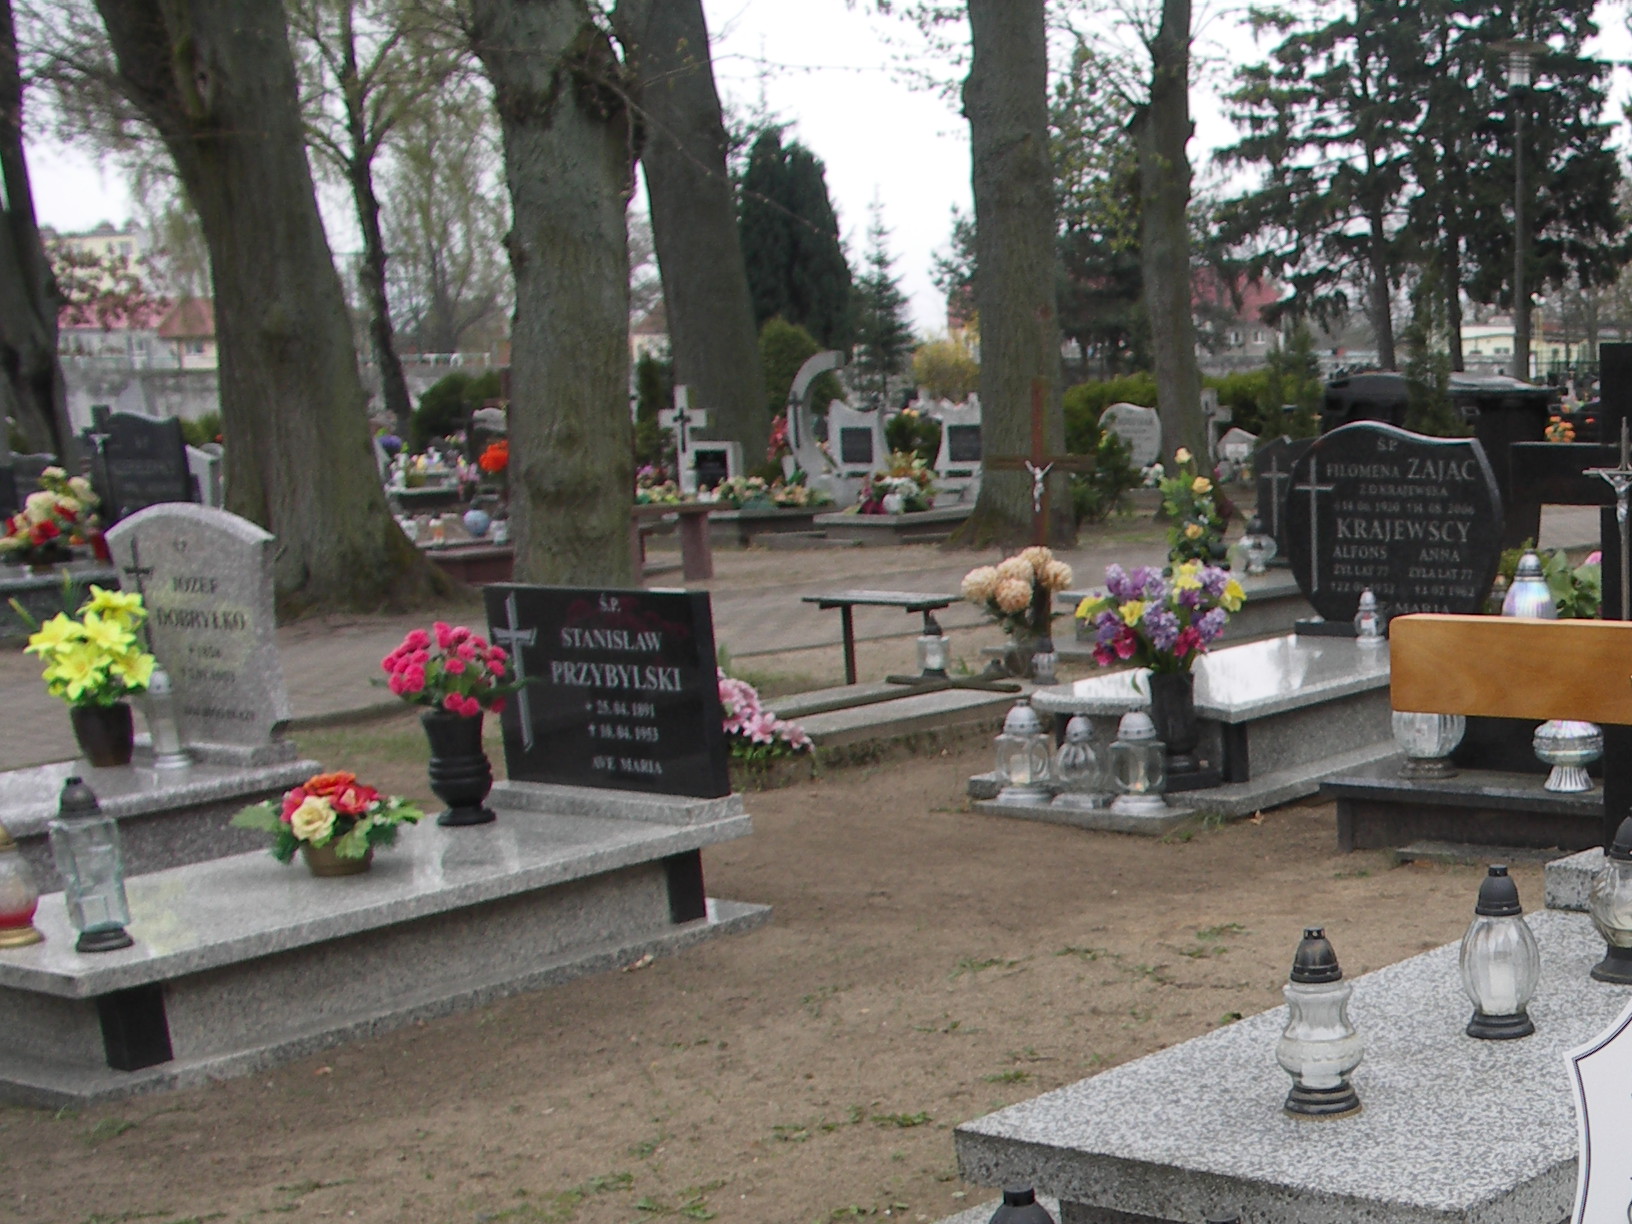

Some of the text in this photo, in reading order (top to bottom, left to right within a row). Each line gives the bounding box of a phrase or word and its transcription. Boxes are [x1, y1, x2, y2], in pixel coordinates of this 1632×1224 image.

[1327, 463, 1400, 478] FILOMENA
[1337, 518, 1471, 542] KRAJEWSCY
[1333, 545, 1460, 562] ALFONS ANNA
[551, 660, 682, 692] PRZYBYLSKI
[620, 757, 662, 774] MARIA
